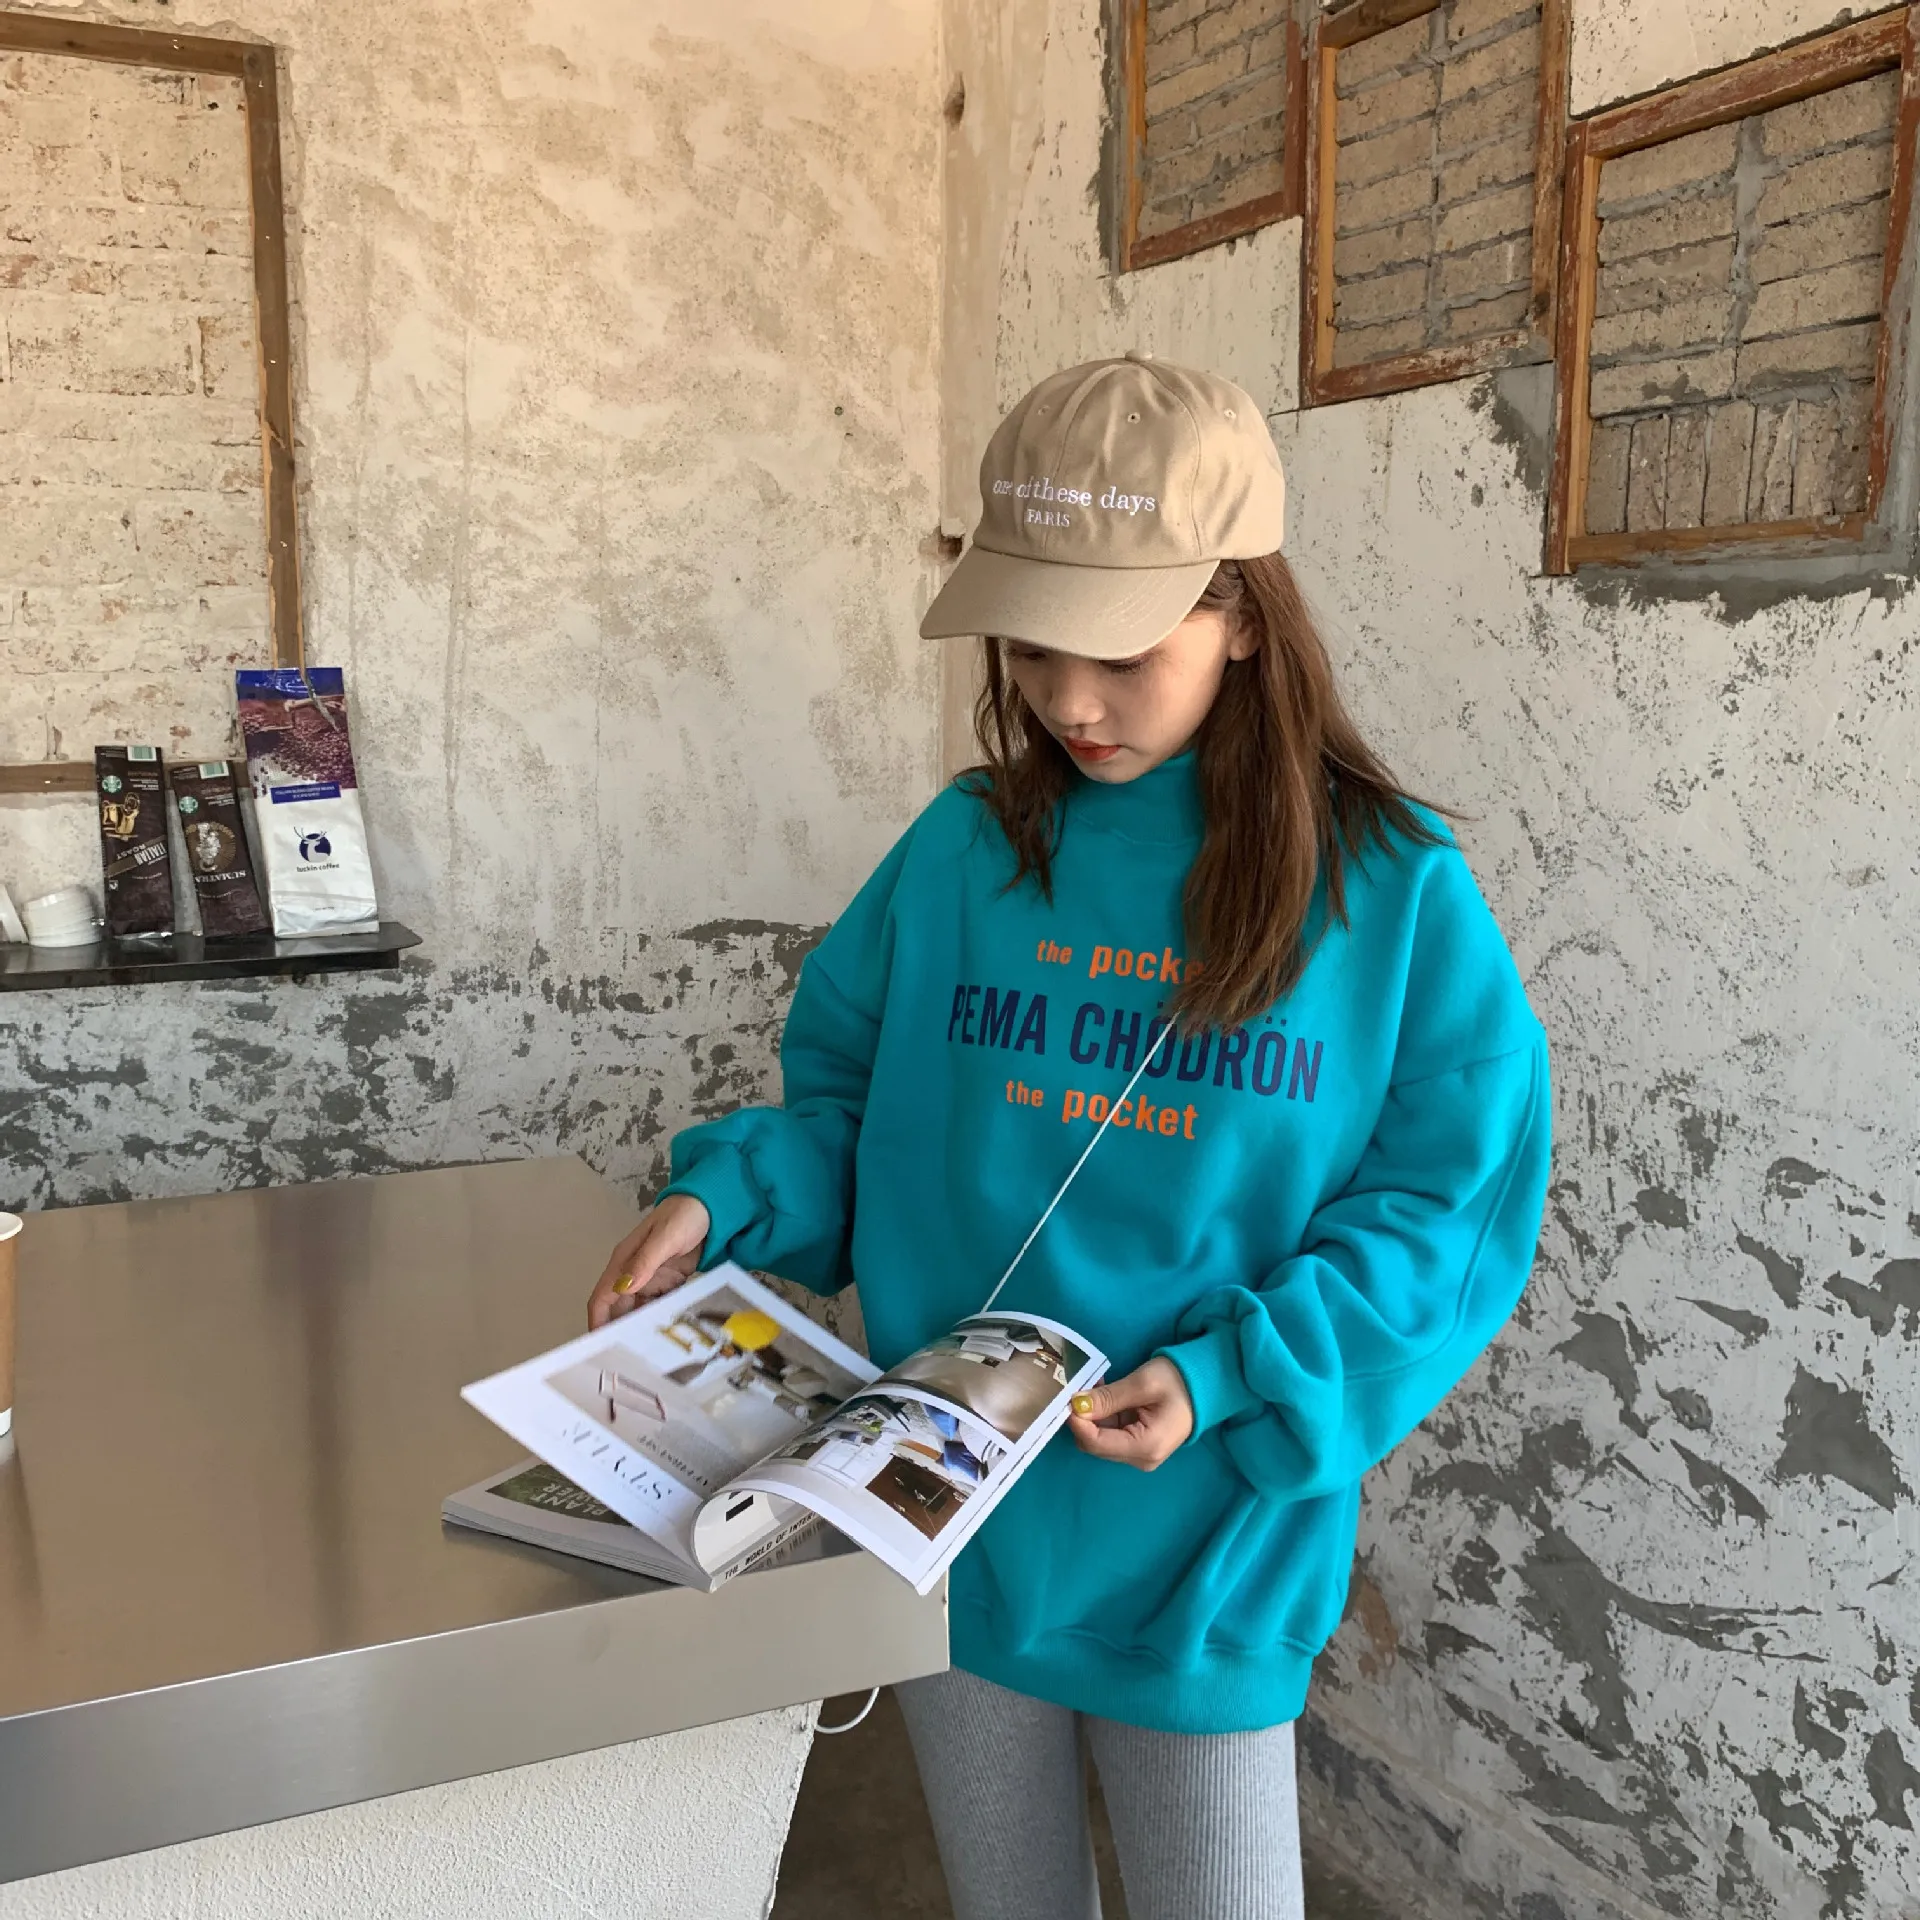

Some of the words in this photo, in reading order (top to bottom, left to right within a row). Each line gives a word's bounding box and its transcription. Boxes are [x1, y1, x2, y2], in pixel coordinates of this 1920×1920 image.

[1034, 477, 1093, 507] these
[1100, 485, 1157, 516] days
[116, 843, 147, 860] ROAST
[134, 842, 167, 866] ITALIAN
[194, 870, 246, 883] SUMATRA
[319, 862, 340, 871] coffee
[1036, 940, 1072, 964] the
[1088, 944, 1206, 985] pocke
[947, 984, 1049, 1056] PEMA
[1006, 1079, 1044, 1108] the
[1061, 1089, 1199, 1140] pocket
[529, 1492, 610, 1517] PLANT
[745, 1541, 773, 1566] WORLD
